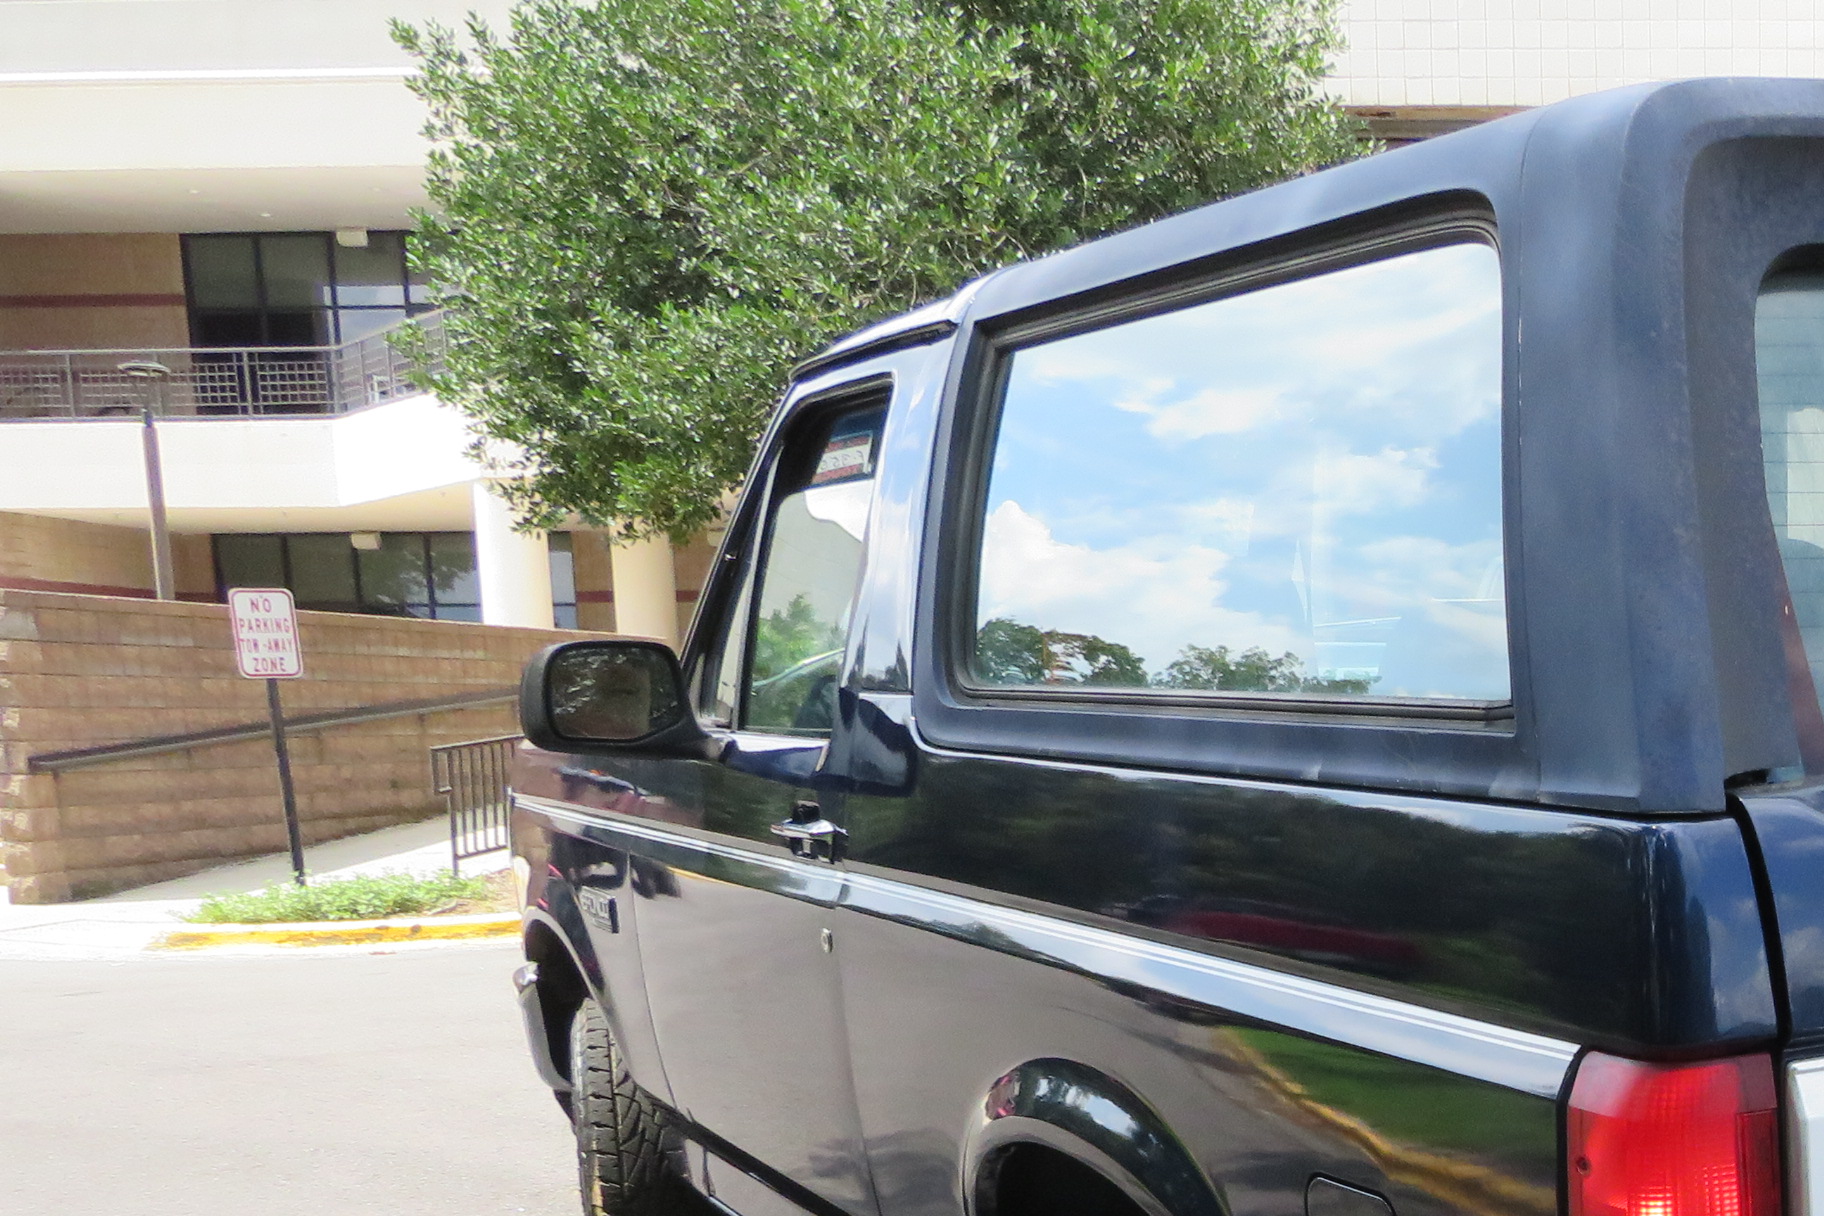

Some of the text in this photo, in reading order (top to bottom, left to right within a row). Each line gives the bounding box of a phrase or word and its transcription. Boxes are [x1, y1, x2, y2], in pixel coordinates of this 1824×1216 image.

[249, 598, 272, 613] NO
[238, 618, 291, 634] PARKING
[238, 638, 293, 654] TOW-AWAY
[252, 657, 288, 672] ZONE
